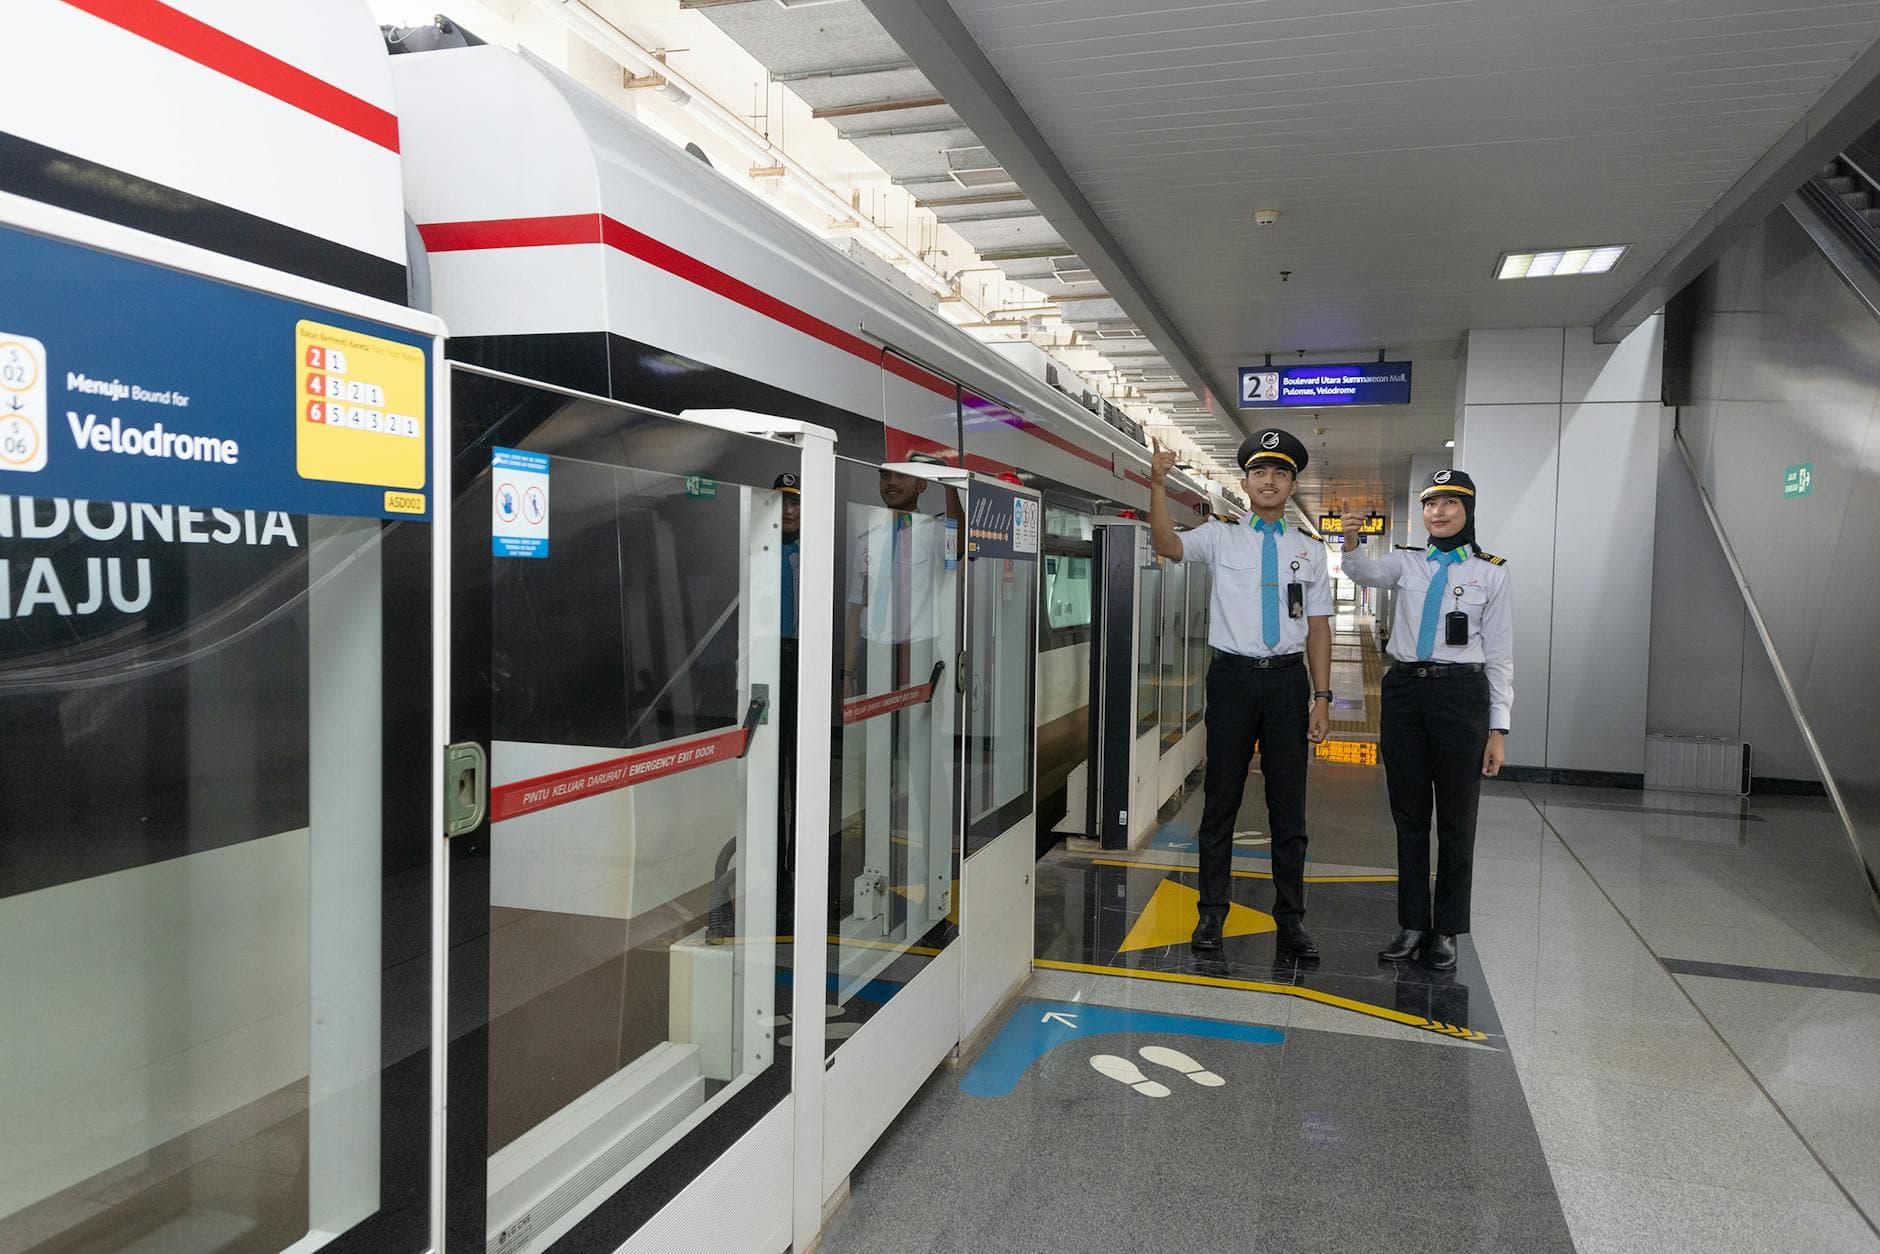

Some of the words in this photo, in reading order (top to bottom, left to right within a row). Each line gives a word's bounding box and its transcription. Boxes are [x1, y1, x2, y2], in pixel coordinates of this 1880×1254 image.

[310, 348, 321, 366] 2
[333, 354, 339, 369] 1
[3, 363, 25, 382] 02
[1282, 376, 1320, 386] Boulevard
[1320, 375, 1342, 385] Utara
[1342, 375, 1388, 385] Summarecon
[66, 371, 129, 402] Menuju
[131, 385, 171, 405] Bound
[171, 391, 190, 407] for
[310, 375, 322, 394] 4
[333, 380, 340, 396] 3
[353, 384, 359, 400] 2
[371, 388, 378, 403] 1
[1247, 375, 1261, 398] 2
[1316, 386, 1356, 396] Velodrome
[310, 403, 322, 421] 6
[333, 407, 339, 423] 5
[352, 411, 360, 426] 4
[371, 413, 378, 429] 3
[390, 416, 396, 431] 2
[407, 420, 413, 434] 1
[4, 436, 26, 454] 06
[66, 411, 240, 464] Velodrome
[389, 496, 421, 510] ASD002
[522, 788, 549, 805] PINTU
[552, 778, 585, 797] KELUAR
[628, 756, 677, 777] EMERGENCY
[678, 750, 693, 762] EXIT
[695, 744, 716, 759] DOOR
